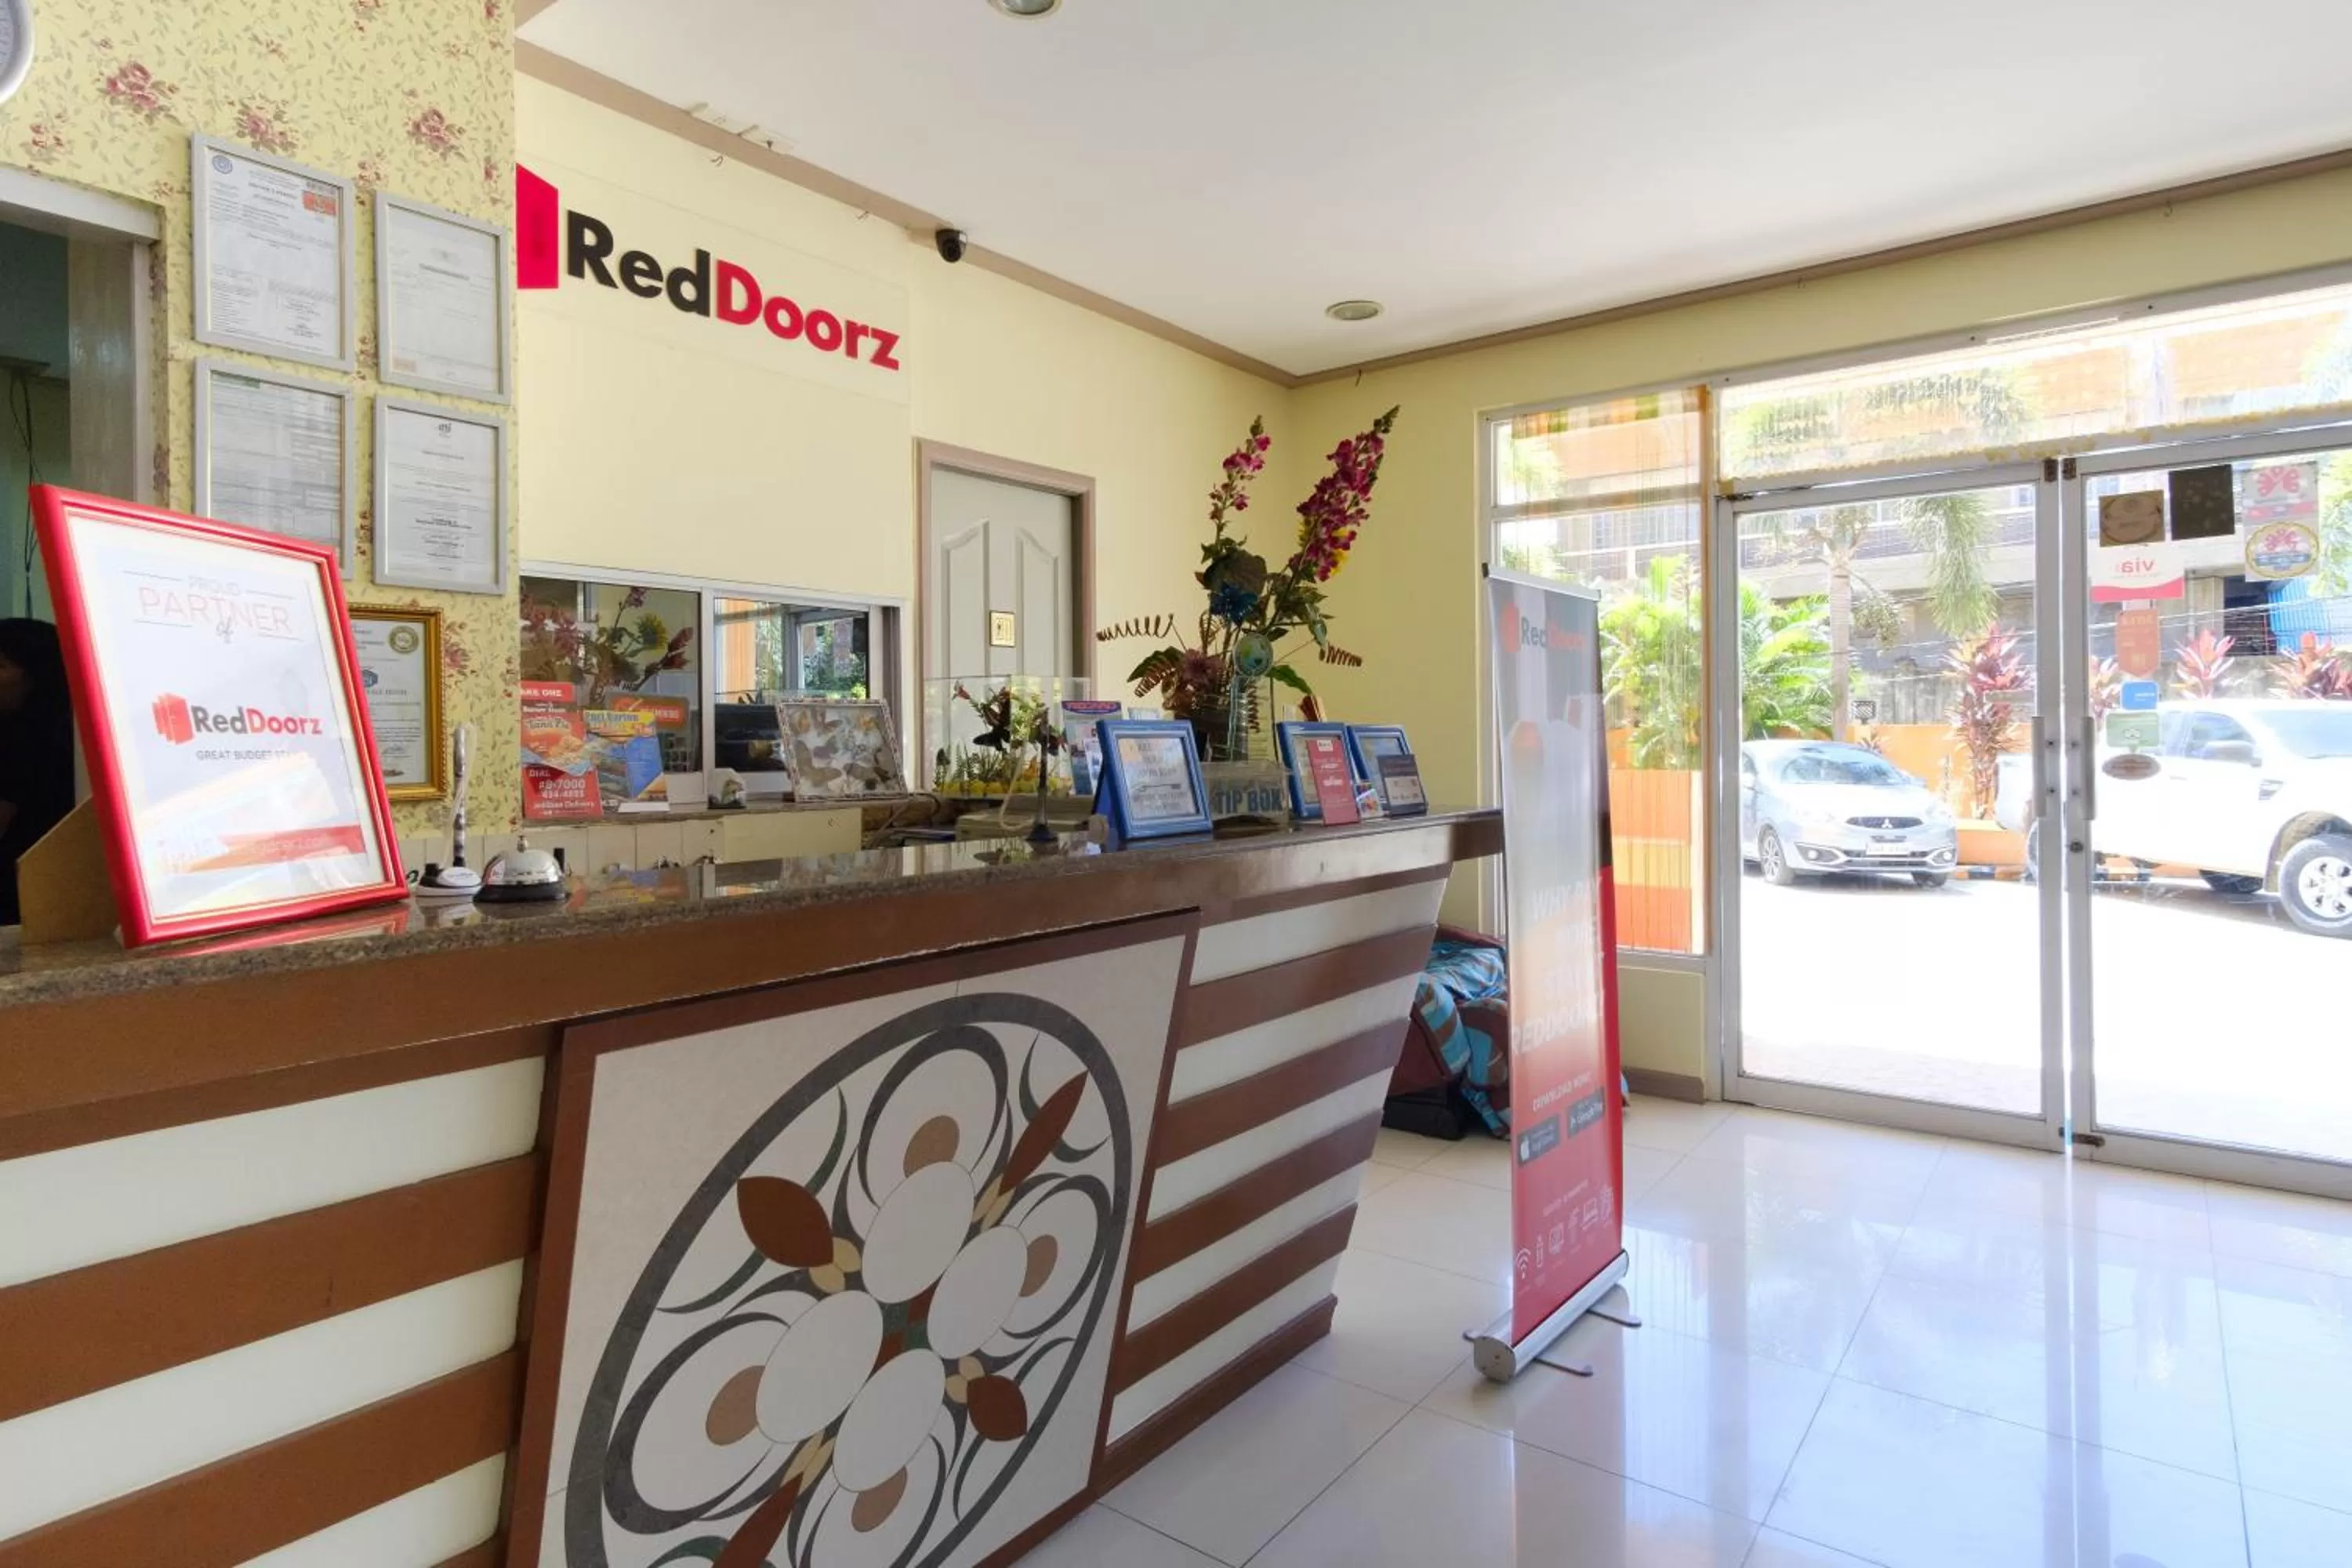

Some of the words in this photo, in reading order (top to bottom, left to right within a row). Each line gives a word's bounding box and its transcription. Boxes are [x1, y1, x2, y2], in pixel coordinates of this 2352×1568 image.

[566, 209, 900, 371] RedDoorz
[138, 585, 293, 633] PARTNER
[191, 705, 323, 735] RedDoorz
[196, 750, 231, 760] GREAT
[234, 750, 272, 760] BUDGET
[1216, 789, 1243, 814] TIP
[1247, 787, 1283, 812] BOX
